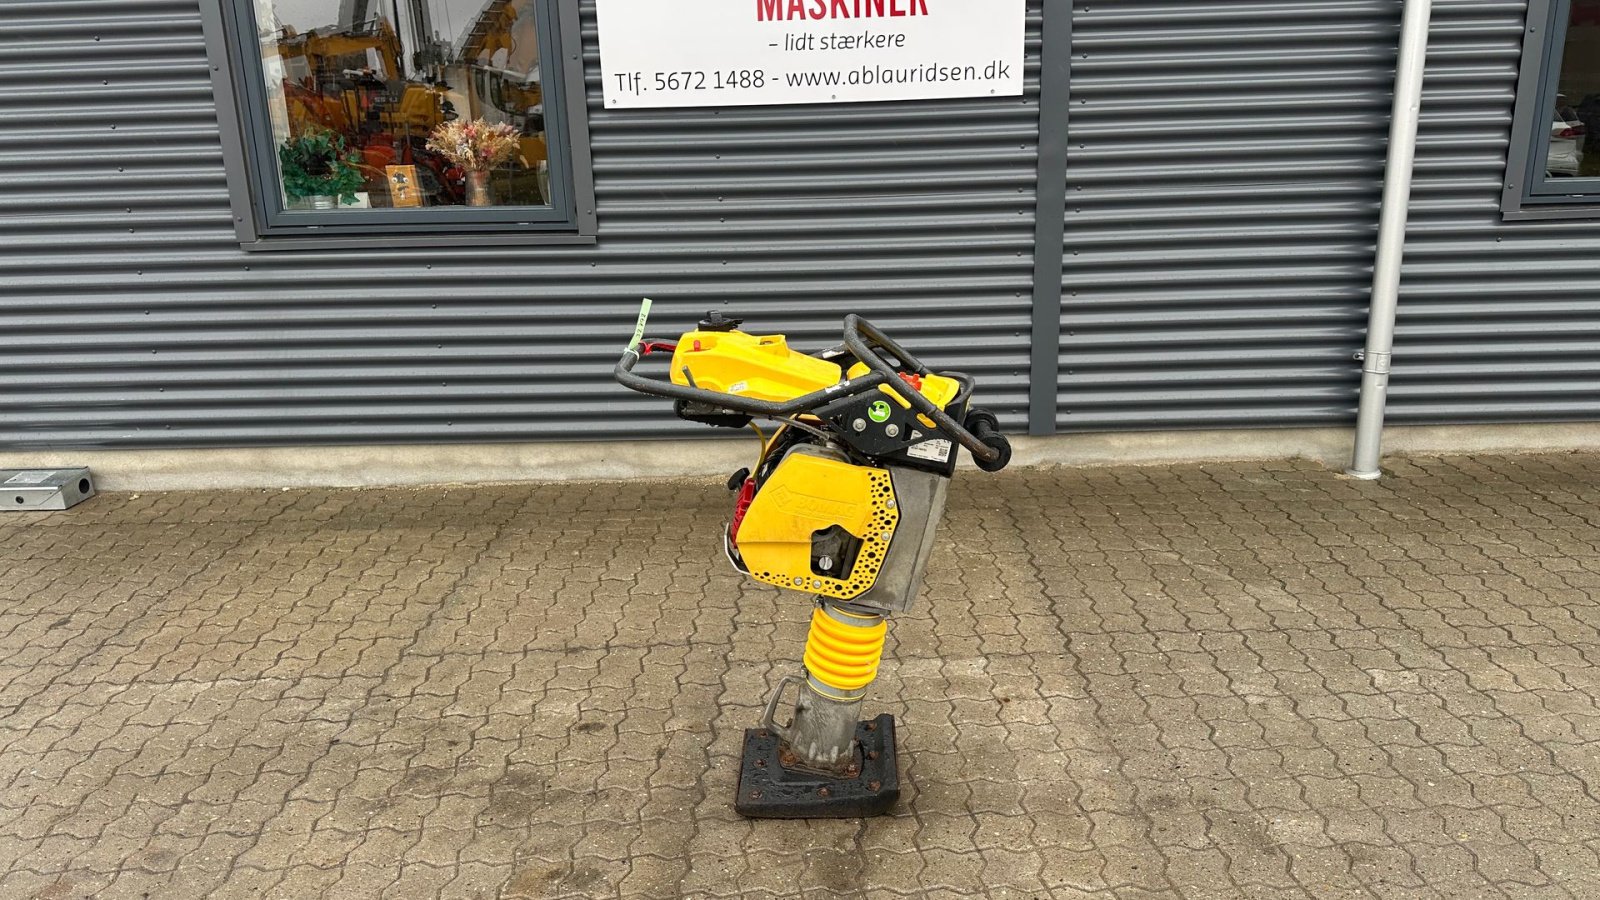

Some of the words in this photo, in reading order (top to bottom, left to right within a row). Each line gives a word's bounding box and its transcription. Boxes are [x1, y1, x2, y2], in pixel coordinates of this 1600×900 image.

[784, 32, 815, 51] lidt
[819, 31, 906, 51] stærkere
[614, 71, 648, 96] Tlf.
[655, 71, 706, 91] 5672
[713, 69, 765, 90] 1488
[786, 59, 1010, 88] www.ablauridsen.dk
